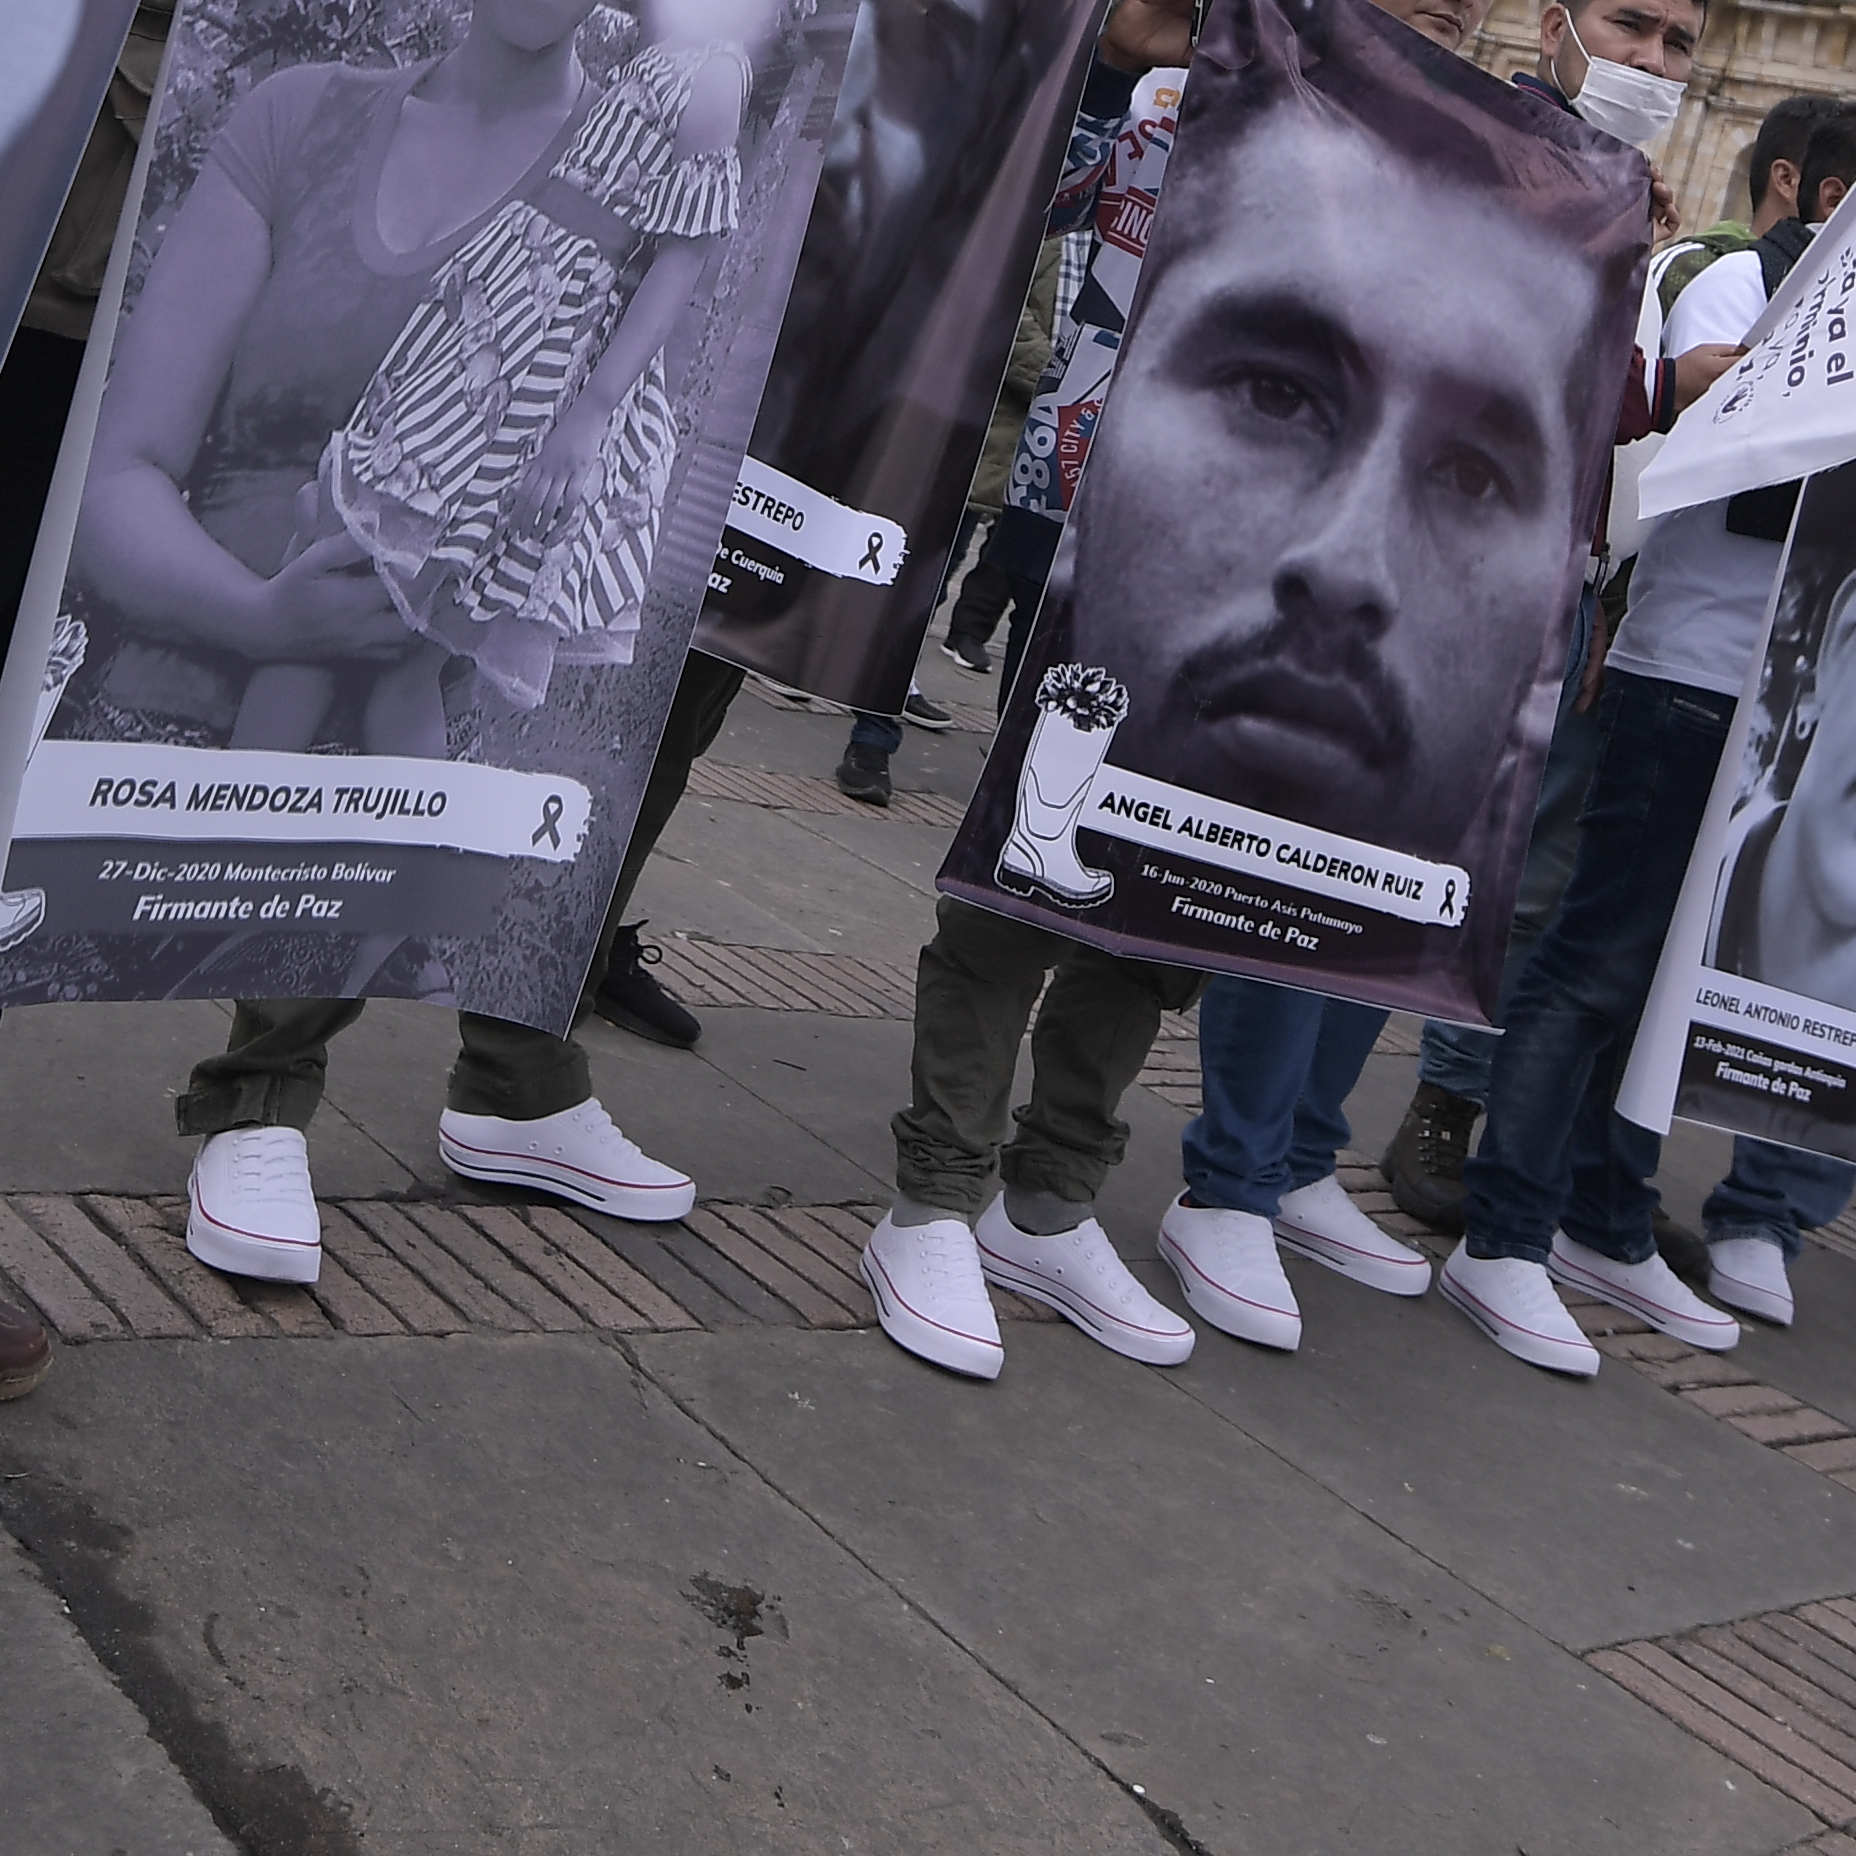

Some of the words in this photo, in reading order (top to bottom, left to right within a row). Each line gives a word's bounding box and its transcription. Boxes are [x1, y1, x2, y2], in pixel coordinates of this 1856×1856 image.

[1826, 352, 1855, 386] el
[1060, 420, 1086, 454] CITY
[707, 572, 733, 595] az
[730, 549, 785, 585] Cuerquia
[89, 777, 177, 810] ROSA
[186, 782, 324, 815] MENDOZA
[331, 786, 447, 820] TRUJILLO
[1098, 791, 1173, 831] ANGEL
[1177, 815, 1271, 858] ALBERTO
[1275, 842, 1380, 889] CALDERON
[1381, 871, 1425, 901] RUIZ
[98, 859, 221, 883] 27-Dic-2020
[224, 862, 329, 884] Montecristo
[331, 862, 397, 884] Bolívar
[132, 894, 254, 921] Firmante
[258, 894, 291, 919] de
[295, 894, 344, 920] Paz
[1140, 864, 1224, 898] 16-Jun-2020
[1224, 885, 1269, 912] Puerto
[1300, 903, 1364, 935] Putumayo
[1170, 895, 1255, 935] Firmante
[1257, 916, 1282, 941] de
[1283, 924, 1320, 952] Paz
[1695, 986, 1742, 1016] LEONEL
[1743, 1000, 1800, 1032] ANTONIO
[1715, 1061, 1770, 1091] Firmante
[1771, 1076, 1788, 1094] de
[1788, 1081, 1813, 1102] Paz
